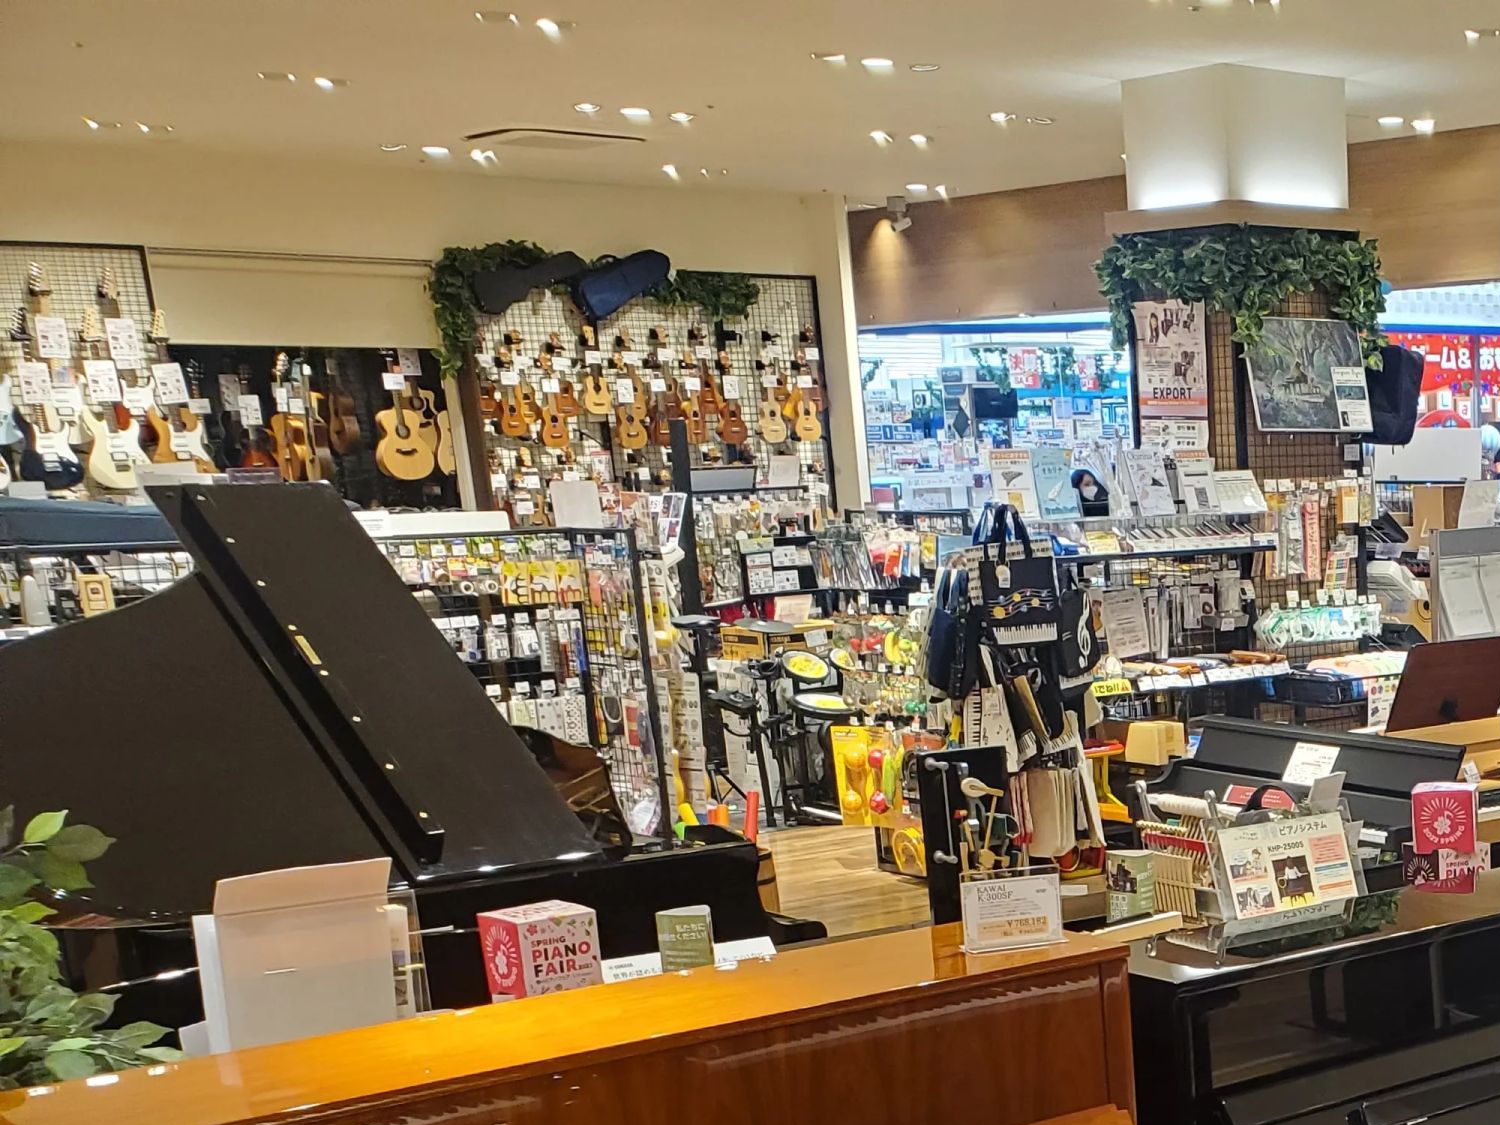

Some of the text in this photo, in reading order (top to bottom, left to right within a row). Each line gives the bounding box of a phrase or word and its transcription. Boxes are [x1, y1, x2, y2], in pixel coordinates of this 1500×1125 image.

[1153, 387, 1193, 399] EXPORT
[1279, 820, 1329, 836] ピアノシステム
[977, 884, 1006, 894] KAWAI
[531, 936, 567, 948] SPRING
[531, 941, 592, 963] PIANO
[533, 959, 577, 978] FAIR
